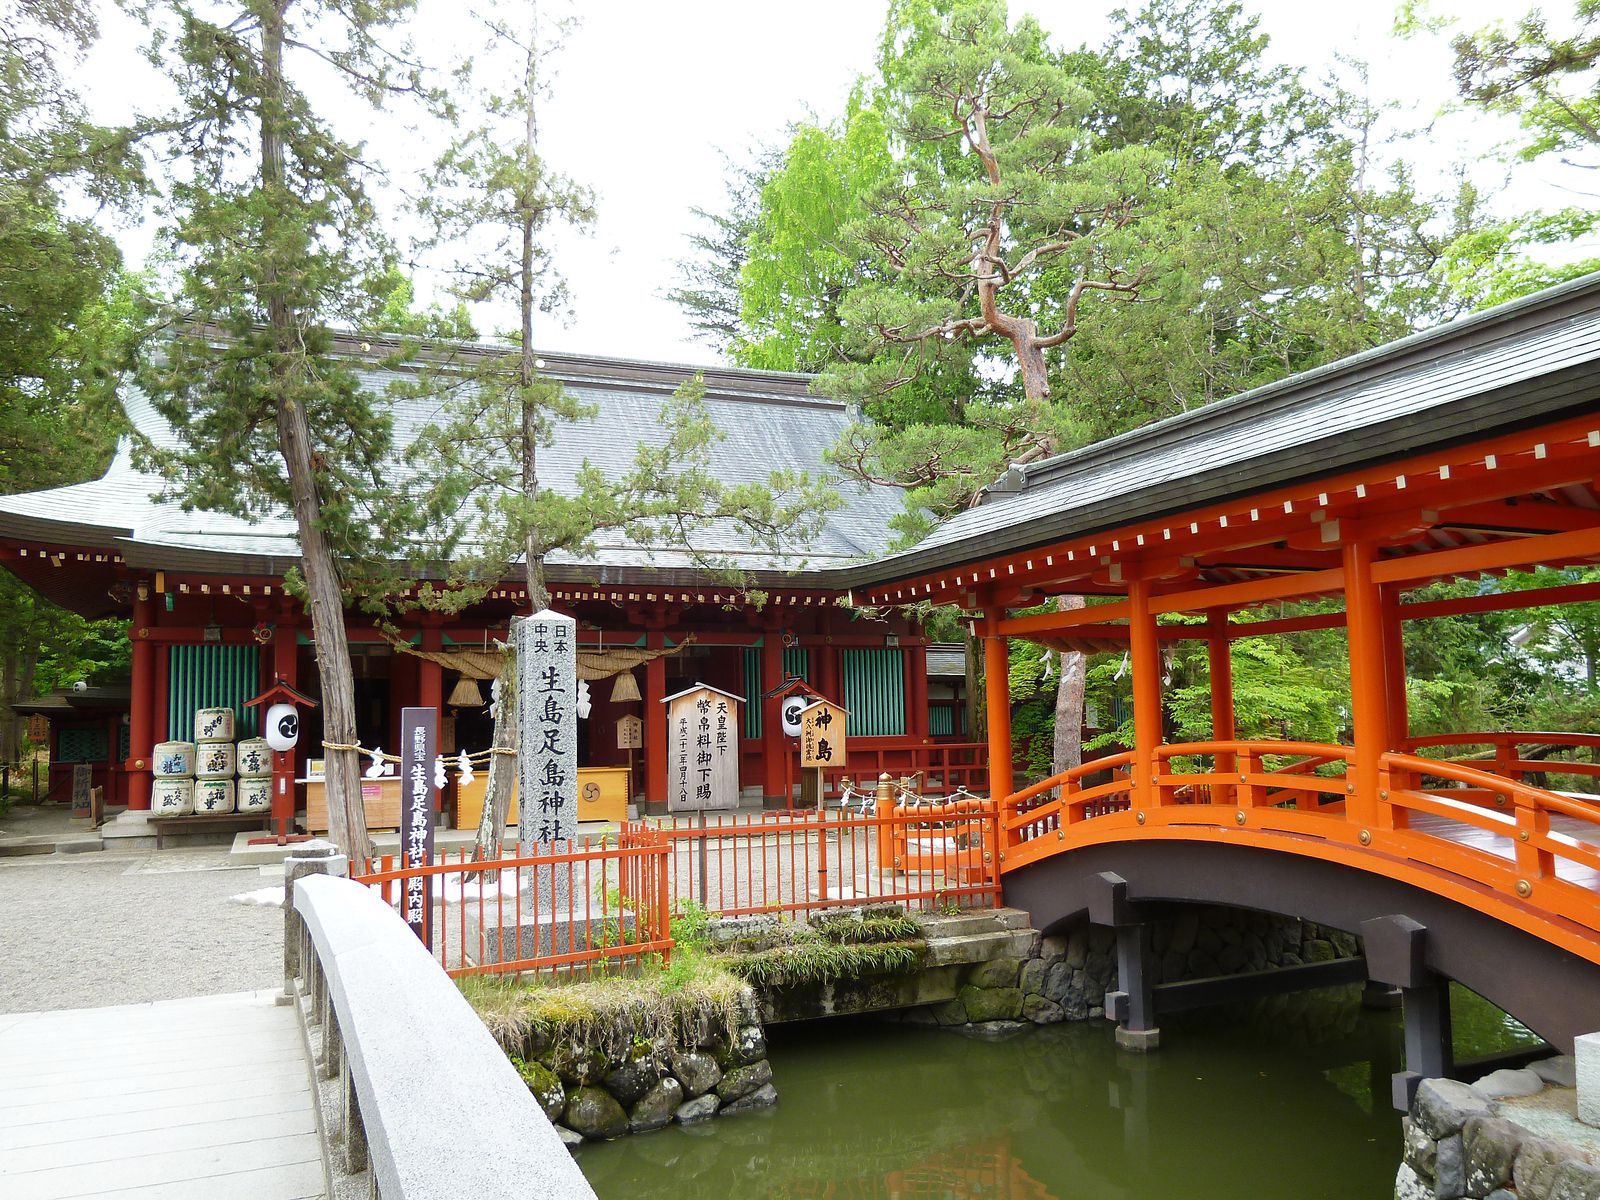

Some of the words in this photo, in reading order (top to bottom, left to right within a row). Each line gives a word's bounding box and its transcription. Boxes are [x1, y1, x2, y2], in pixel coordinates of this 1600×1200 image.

[534, 623, 549, 653] 中央
[554, 625, 569, 654] 日本
[414, 726, 427, 761] 長野県宝
[537, 665, 566, 844] 生島足島神社
[716, 702, 728, 756] 天皇陛下
[815, 707, 833, 761] 神島
[679, 717, 688, 802] 平成二十二年四月十八日
